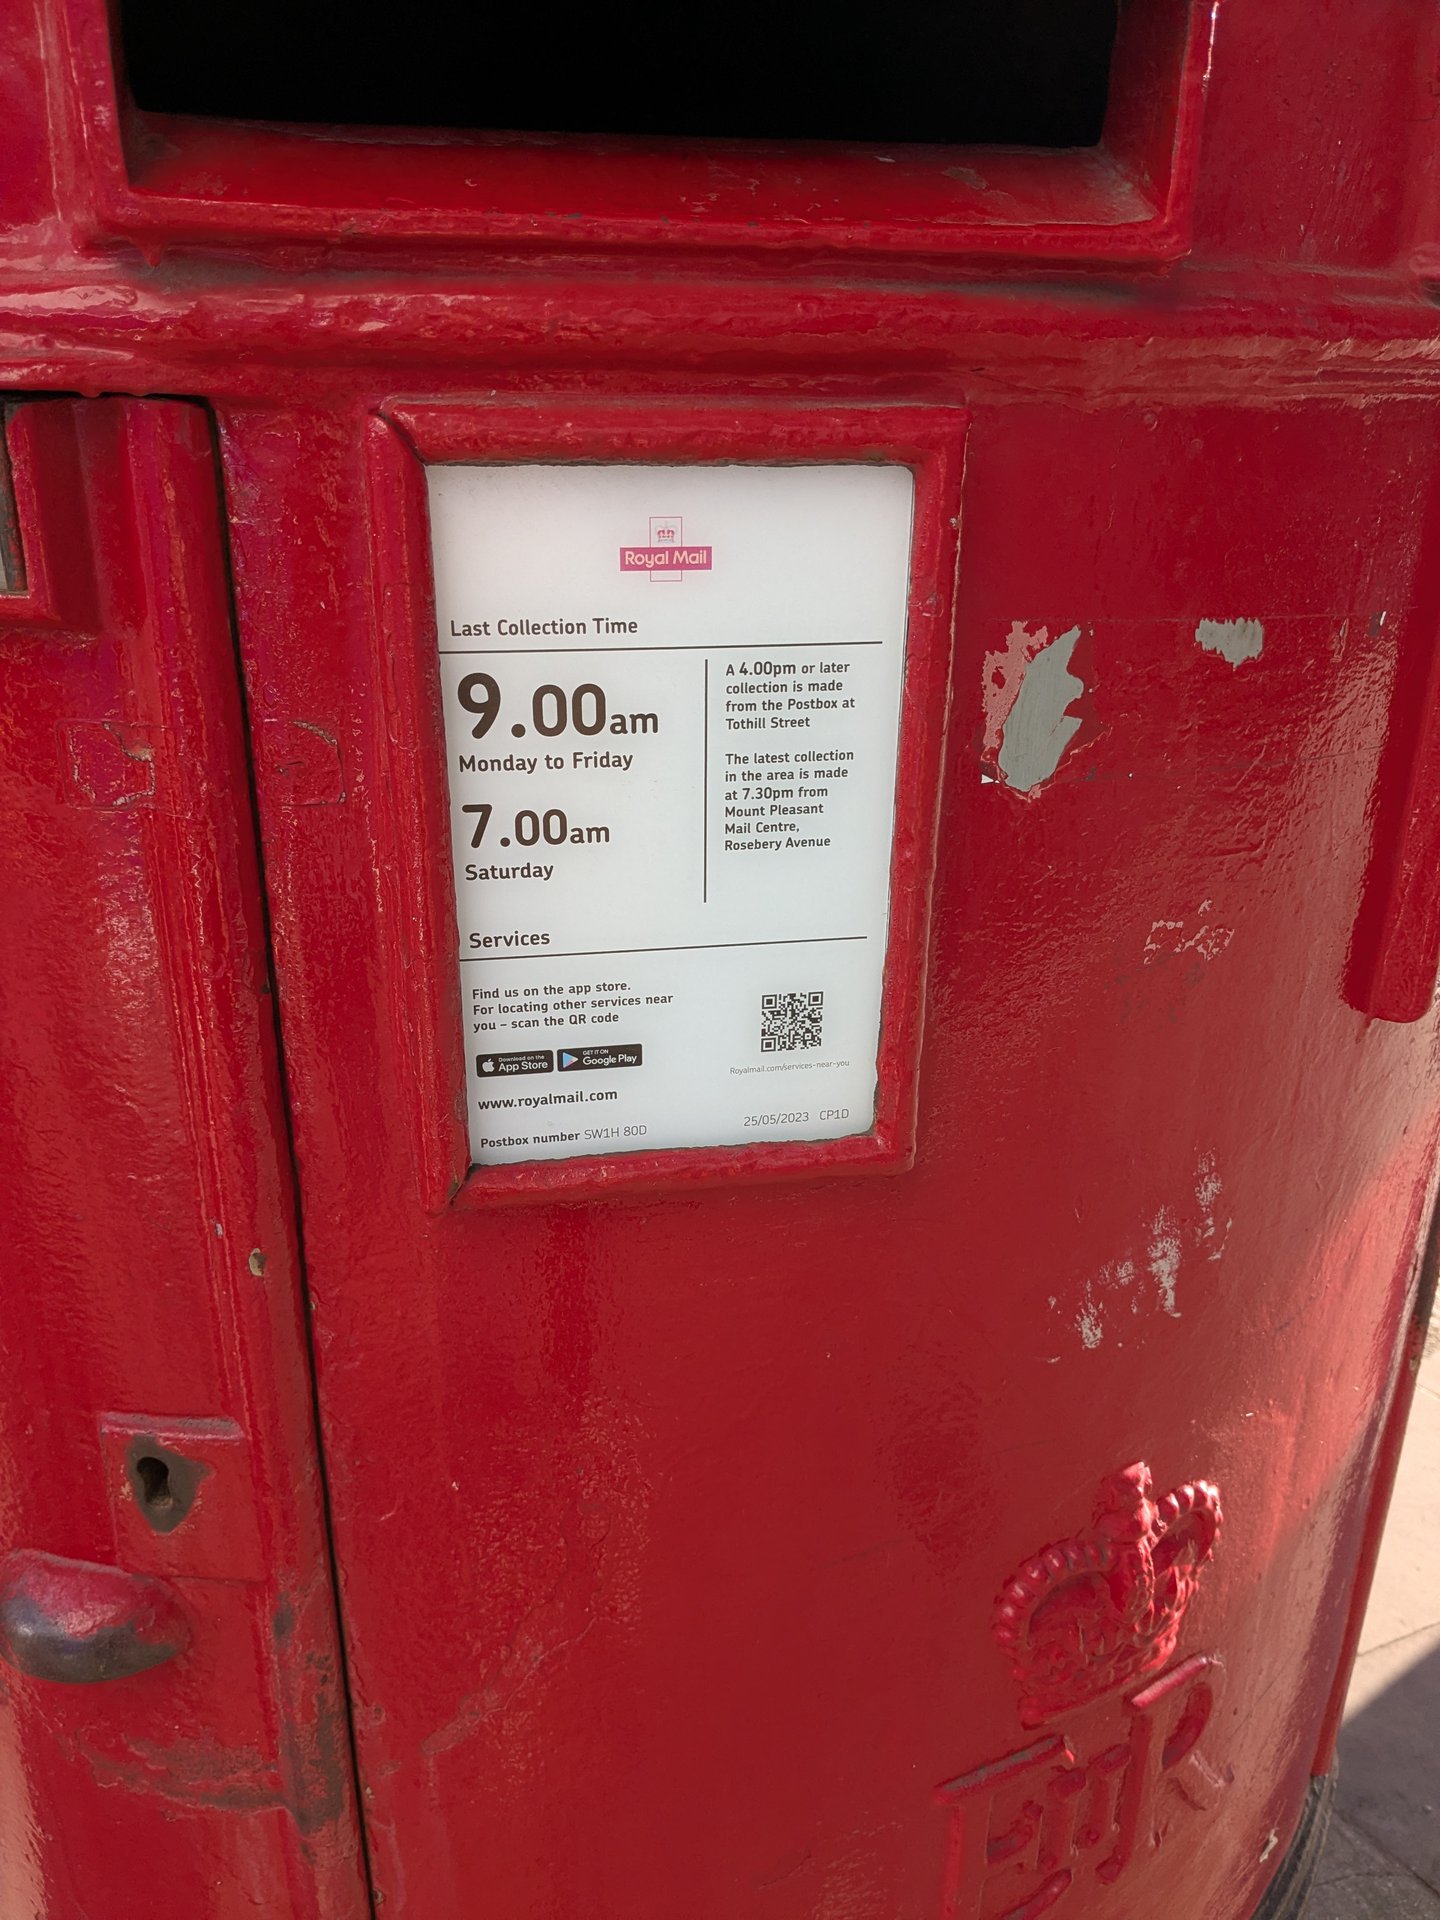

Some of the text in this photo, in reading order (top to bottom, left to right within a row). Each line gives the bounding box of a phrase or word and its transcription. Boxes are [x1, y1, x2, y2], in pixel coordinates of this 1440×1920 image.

[624, 550, 707, 569] Royal Mail
[450, 618, 638, 637] Last Collection Time
[726, 661, 850, 677] A 4.00pm or later
[726, 680, 843, 694] collection is made
[457, 672, 659, 739] 9.00am
[726, 698, 855, 712] from the Postbox at
[726, 716, 811, 730] Tothill Street
[459, 751, 634, 774] Monday to Friday
[725, 750, 854, 765] The latest collection
[725, 767, 848, 782] in the area is made
[725, 786, 828, 801] at 7.30pm from
[725, 803, 824, 818] Mount Pleasant
[461, 803, 611, 848] 7.00am
[725, 821, 800, 834] Mail Centre,
[725, 837, 831, 851] Rosebery Avenue
[465, 862, 554, 881] Saturday
[469, 930, 550, 949] Services
[472, 981, 631, 1000] Find us on the app store.
[473, 994, 674, 1015] For locating other services near
[473, 1021, 496, 1033] you
[511, 1018, 539, 1029] scan
[543, 1016, 564, 1027] the
[568, 1014, 586, 1026] QR
[590, 1013, 619, 1024] code
[498, 1060, 549, 1073] App Store
[582, 1054, 638, 1066] Google Play
[730, 1060, 850, 1075] Royalmail.com/services-near-you
[478, 1091, 618, 1110] www.royalmail.com
[743, 1108, 850, 1127] 25/05/2023 CP1D
[481, 1137, 529, 1148] Postbox
[533, 1131, 580, 1144] number
[584, 1126, 620, 1140] SW1H
